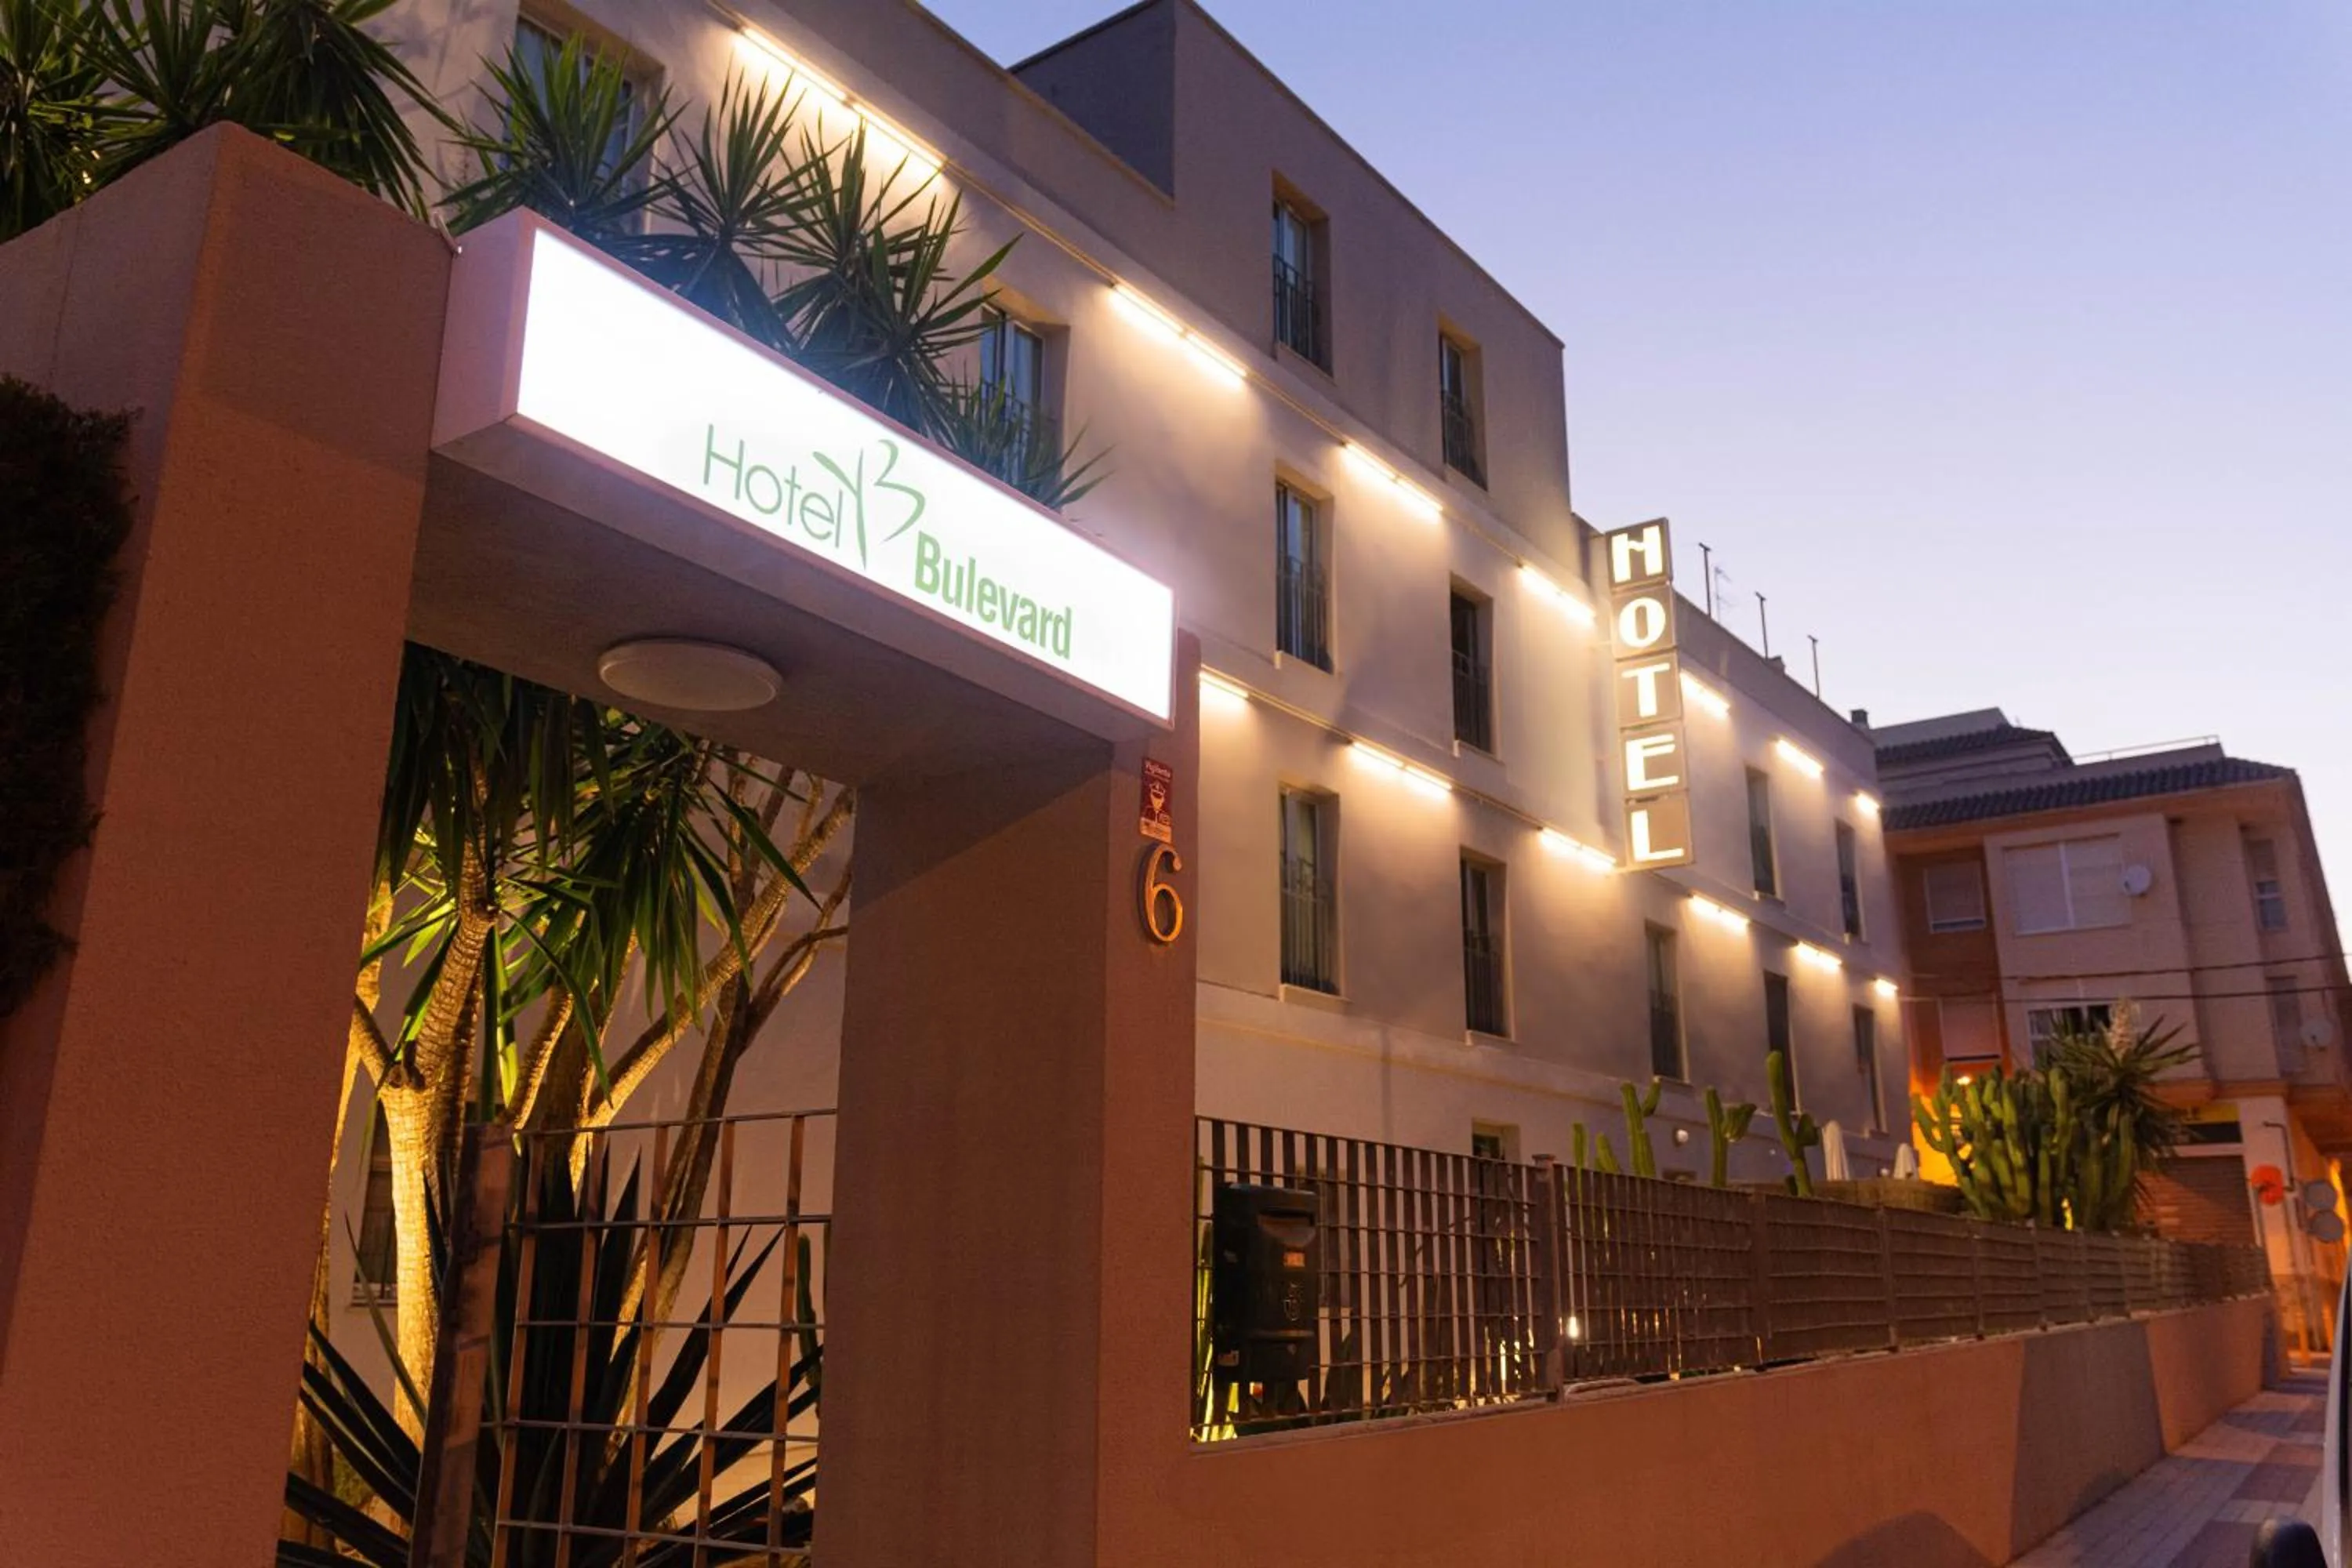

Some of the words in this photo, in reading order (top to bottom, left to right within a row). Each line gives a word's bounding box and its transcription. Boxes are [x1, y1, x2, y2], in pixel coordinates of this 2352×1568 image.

[704, 423, 843, 548] Hotel
[914, 531, 1073, 659] Bulevard
[1612, 524, 1684, 862] HOTEL
[1145, 844, 1183, 942] 6
